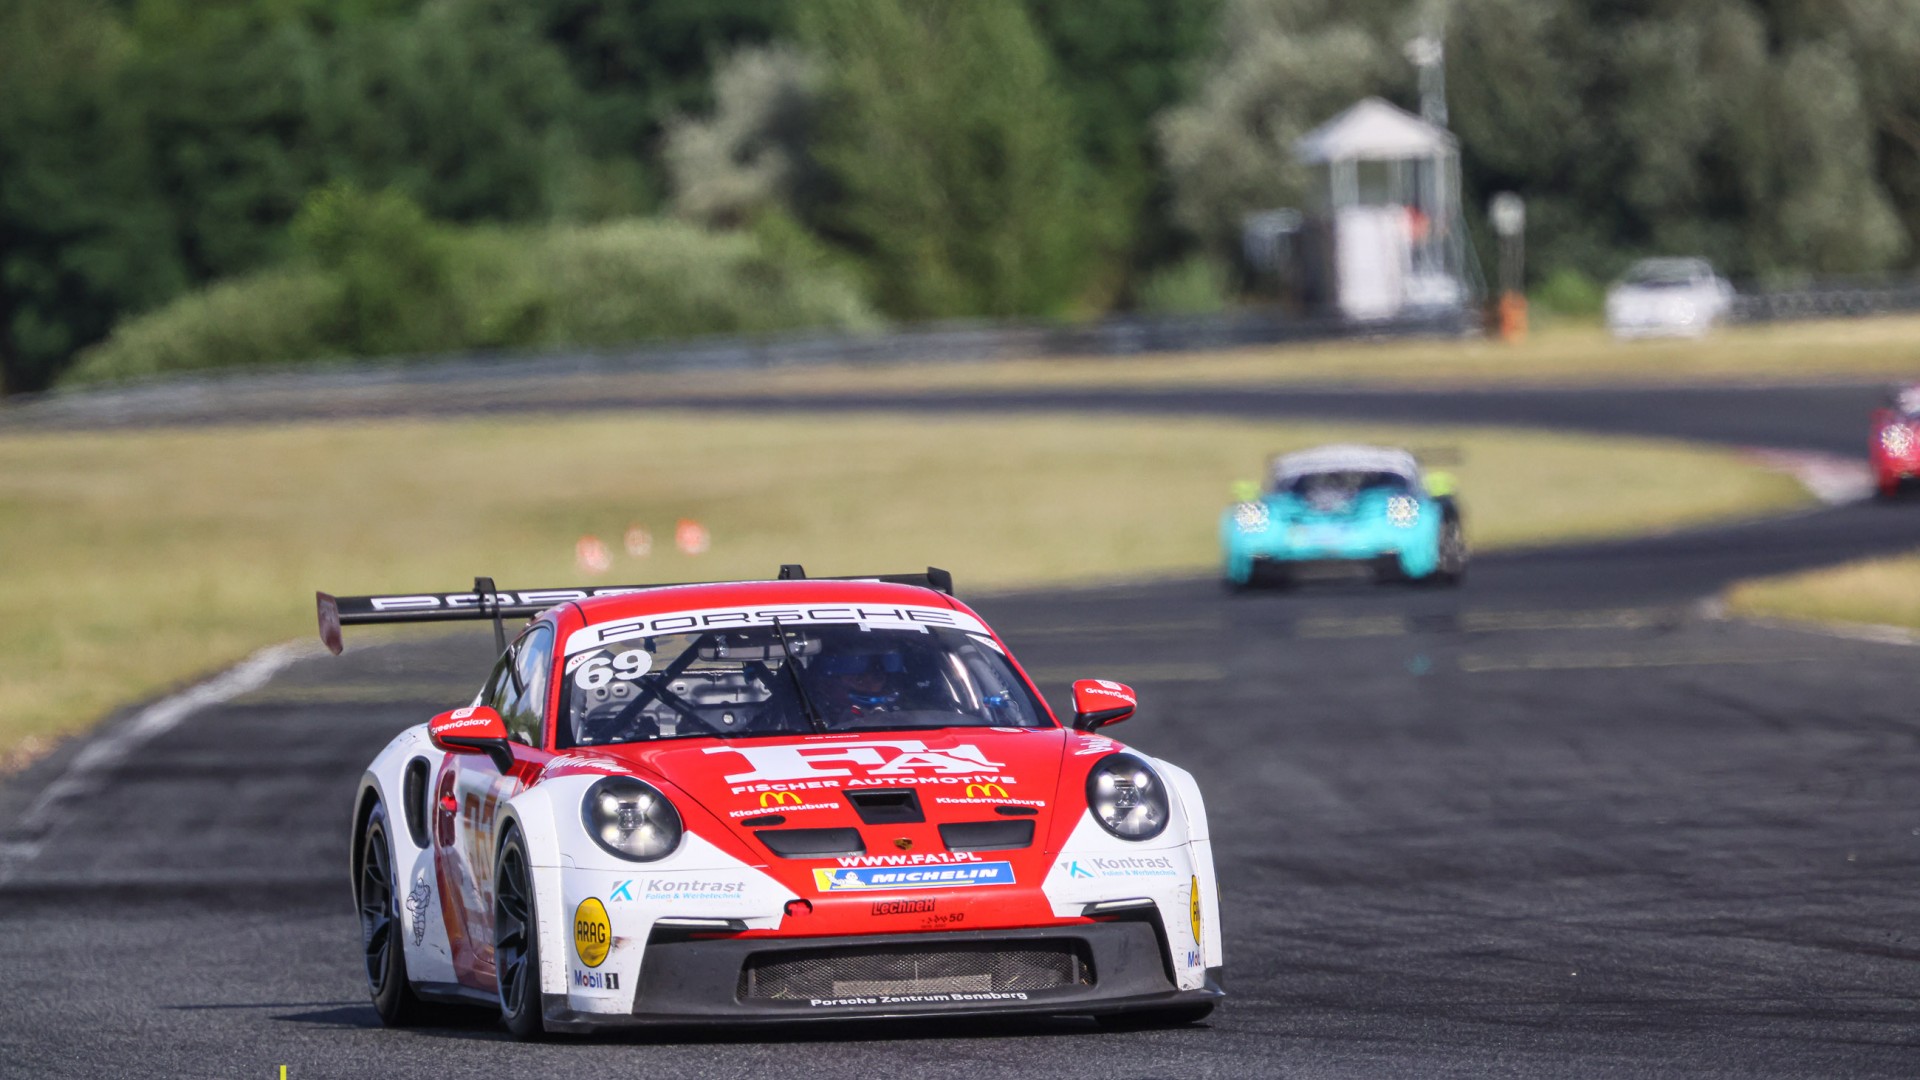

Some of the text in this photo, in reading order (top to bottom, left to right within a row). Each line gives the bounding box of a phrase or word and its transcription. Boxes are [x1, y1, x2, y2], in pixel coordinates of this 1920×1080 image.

[598, 608, 956, 641] PORSCHE
[575, 649, 653, 690] 69
[731, 775, 1017, 795] FISCHER AUTOMOTIVE
[935, 797, 1046, 807] Klosterneuburg
[729, 802, 840, 818] Klosterneuburg
[837, 852, 982, 867] WWW.FA1.PL
[1092, 856, 1174, 869] Kontrast
[871, 868, 999, 883] MICHELIN
[647, 880, 746, 892] Kontrast
[949, 912, 964, 922] 50
[577, 920, 606, 943] ARAG
[574, 969, 617, 989] Mobil 1
[811, 991, 1028, 1006] Porsche Zentrum Bensberg
